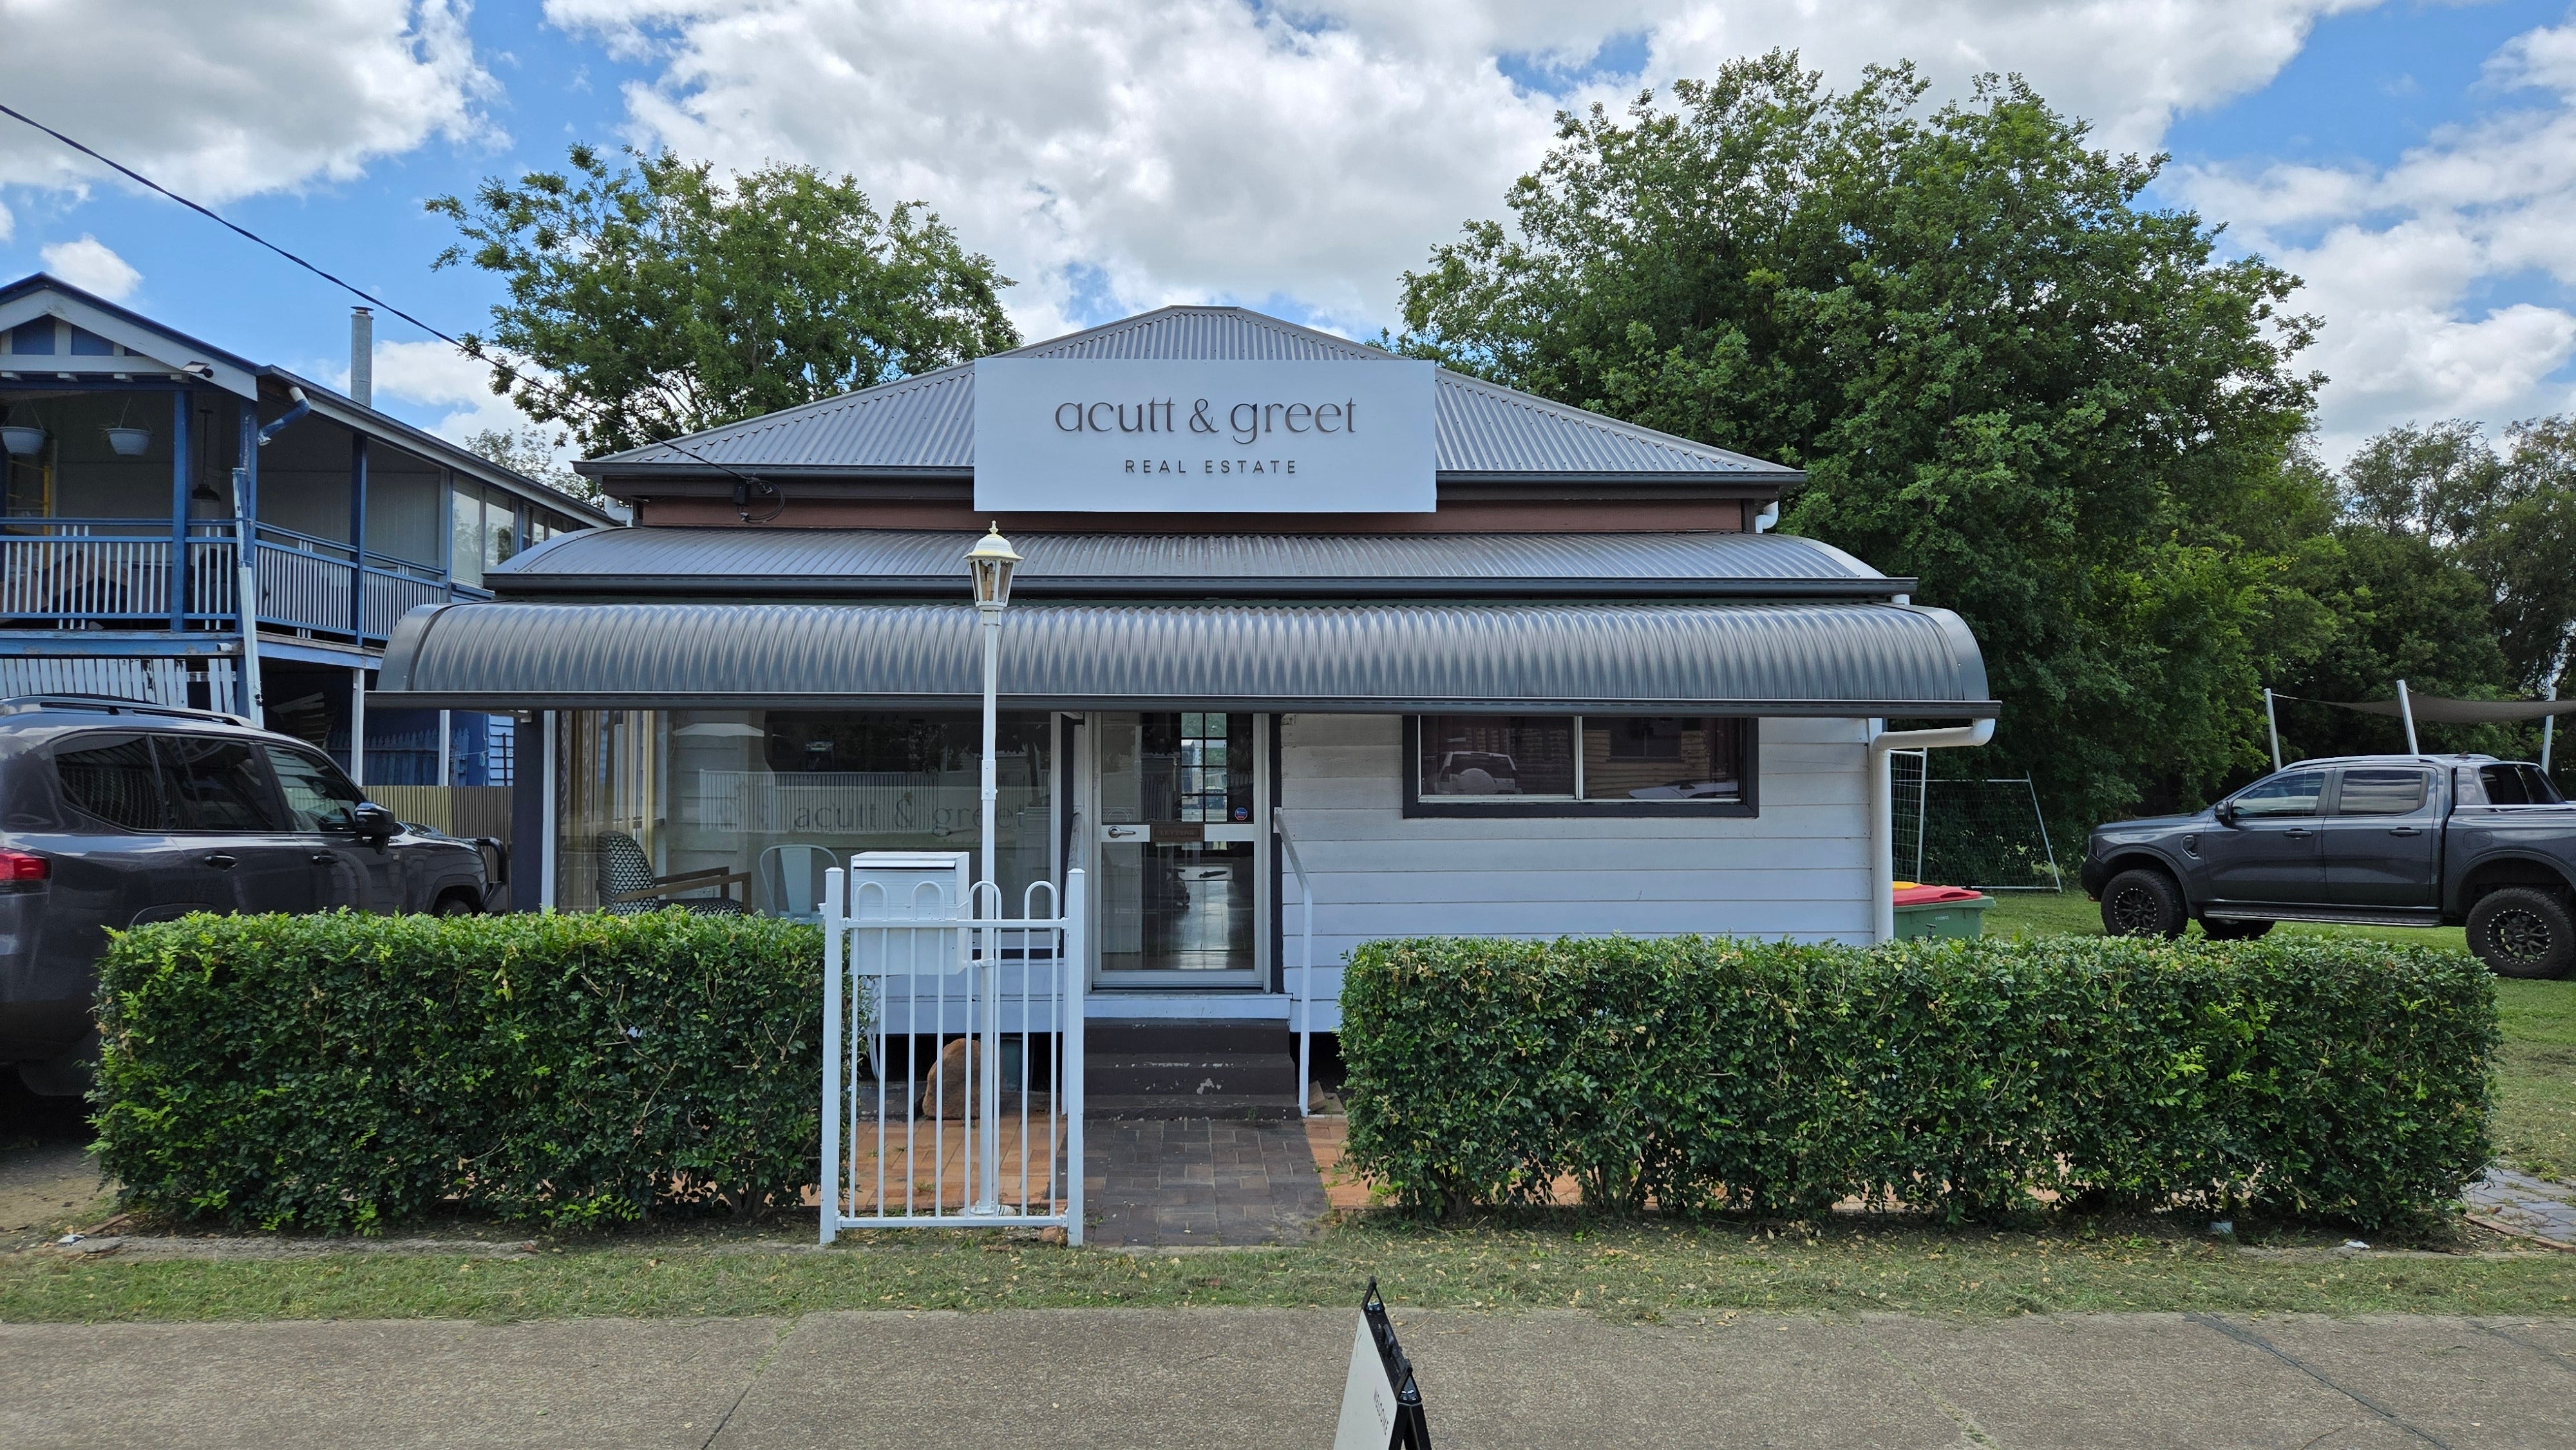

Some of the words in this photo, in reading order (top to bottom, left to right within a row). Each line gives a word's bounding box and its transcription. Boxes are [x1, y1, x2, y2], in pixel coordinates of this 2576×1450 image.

[1055, 397, 1175, 433] acutt
[1189, 399, 1219, 433] &
[1230, 397, 1356, 444] greet
[1126, 460, 1186, 474] REAL
[1206, 460, 1296, 474] ESTATE
